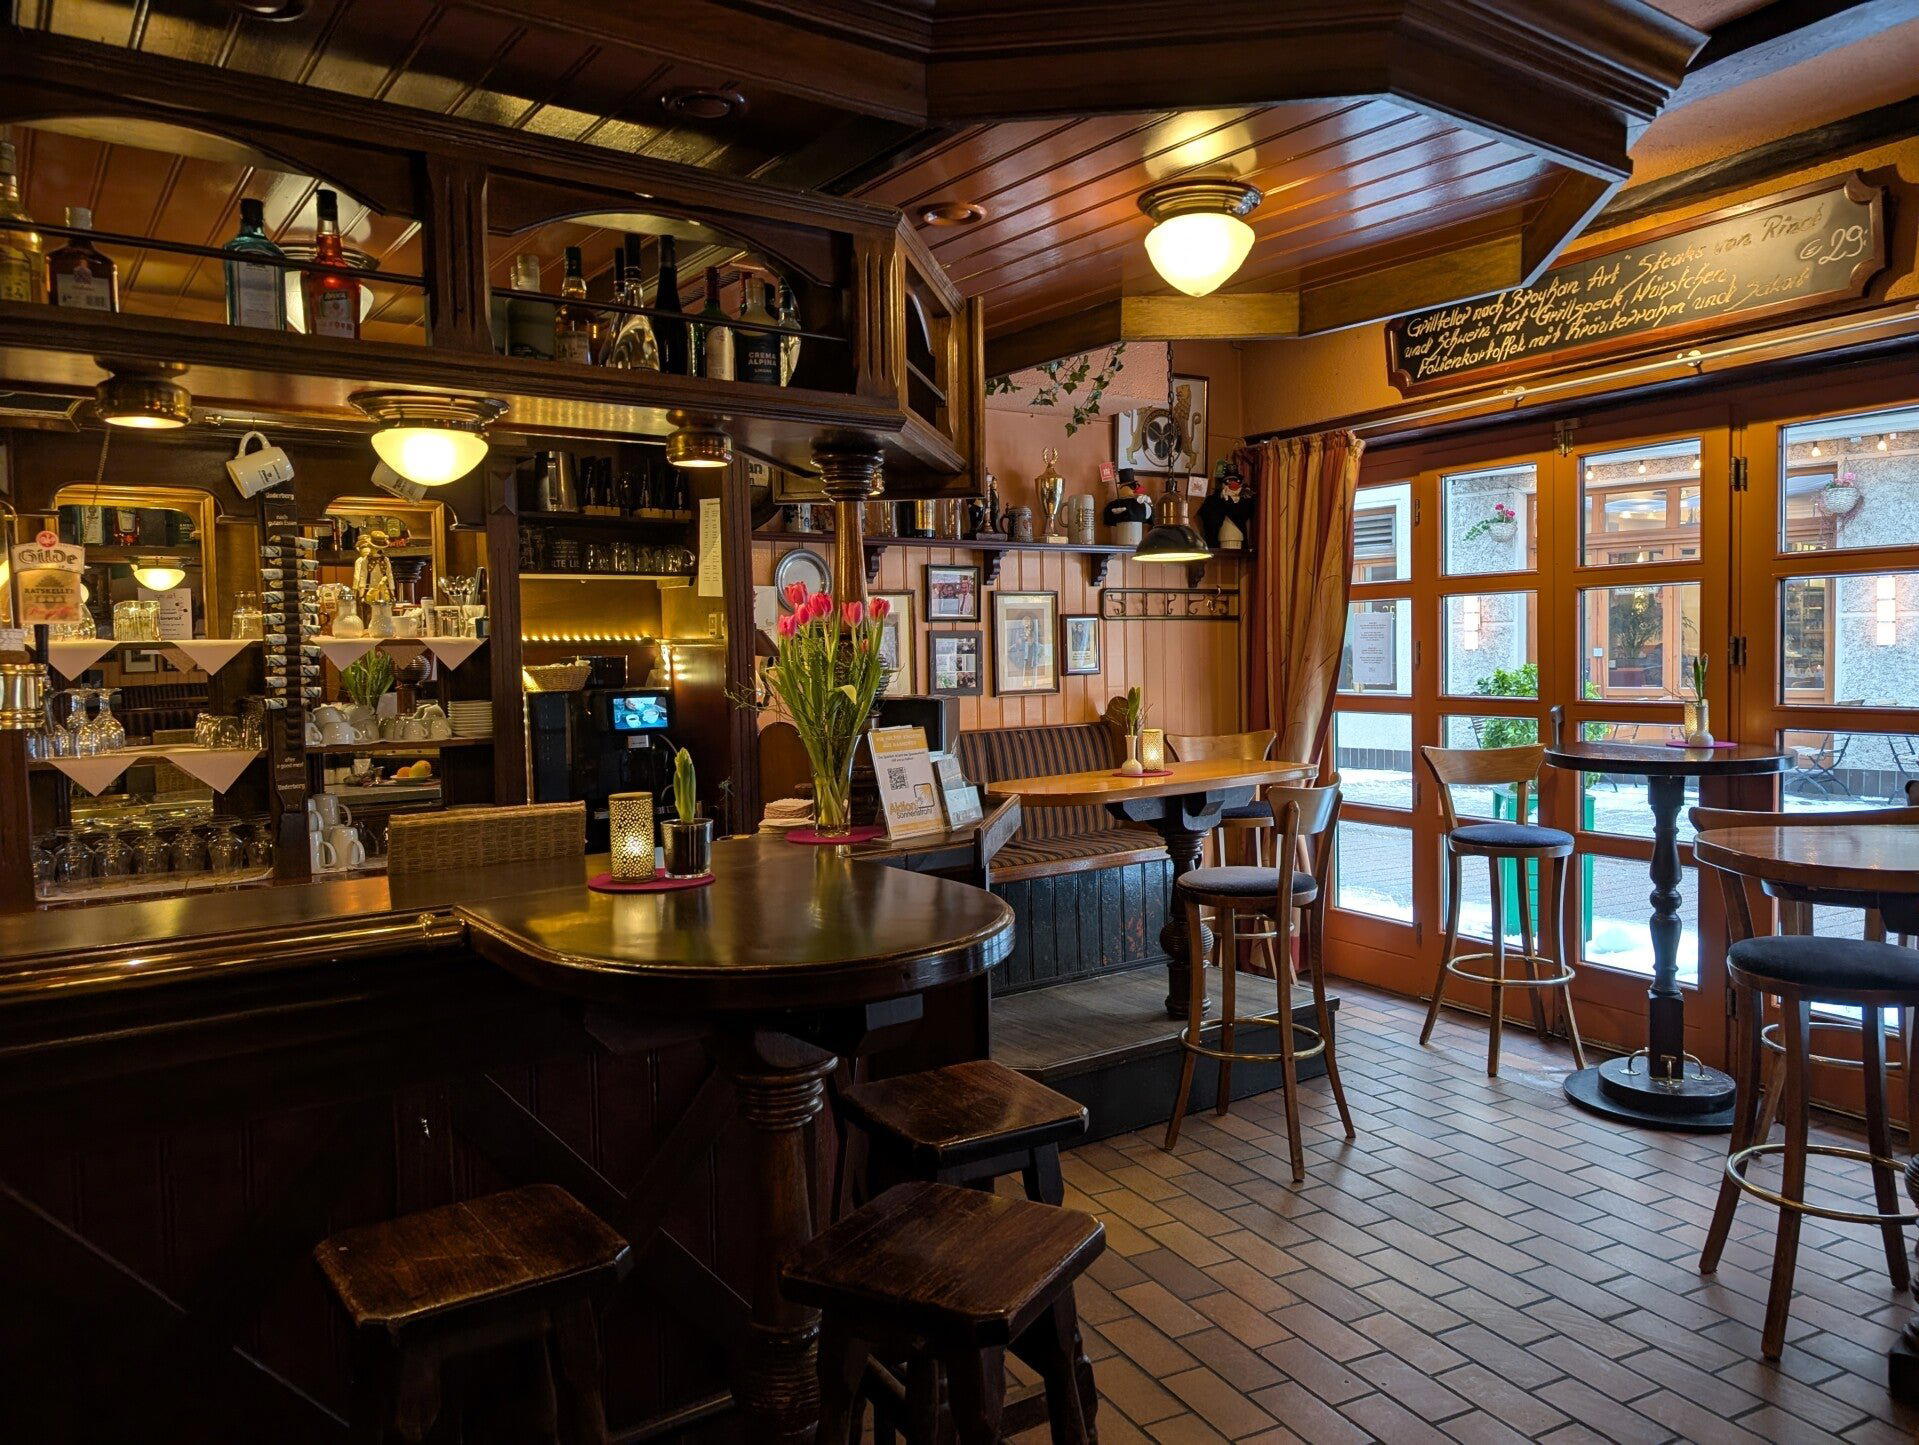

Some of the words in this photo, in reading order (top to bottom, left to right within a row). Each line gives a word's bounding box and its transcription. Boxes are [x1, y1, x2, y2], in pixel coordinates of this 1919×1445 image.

[1407, 307, 1471, 337] Grillteller
[1472, 291, 1507, 324] nach
[1620, 243, 1705, 290] Steaks
[1762, 202, 1825, 243] Rind
[1404, 336, 1433, 359] und
[1424, 321, 1491, 363] Schwein
[1497, 312, 1527, 333] mit
[1417, 330, 1526, 379] Folienkartoffel
[1528, 323, 1564, 349] mit
[1692, 274, 1738, 310] und
